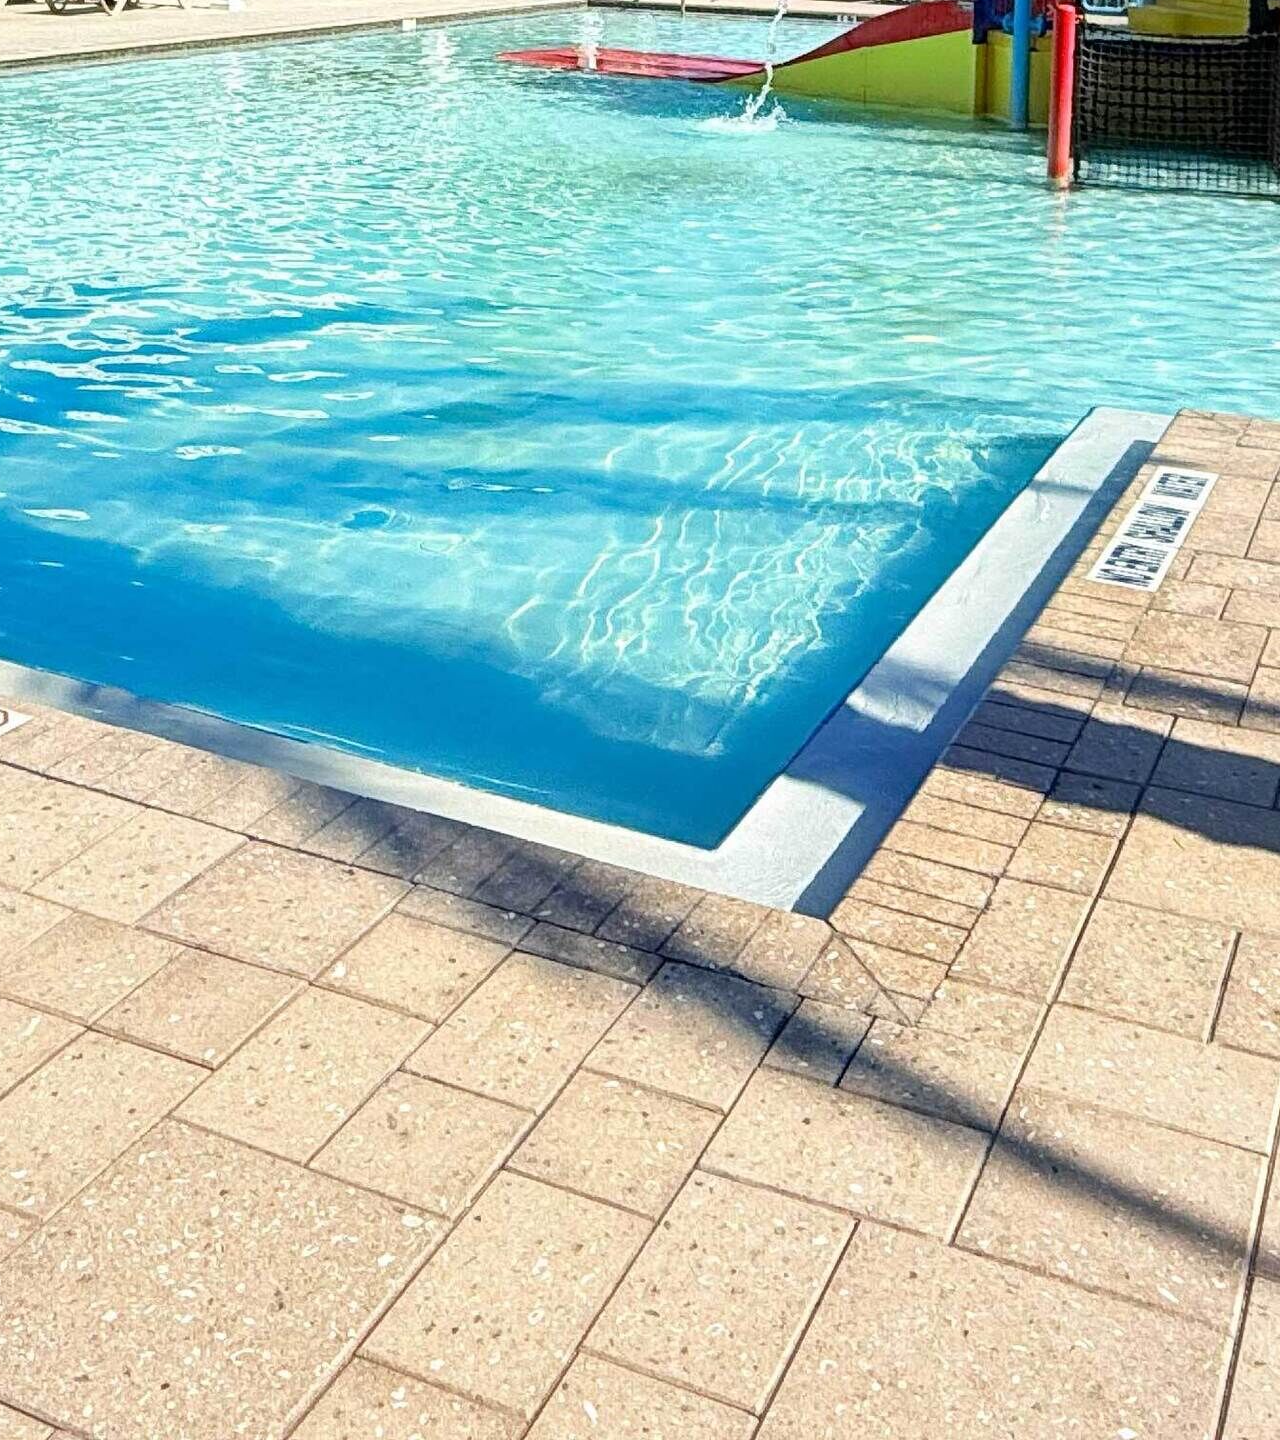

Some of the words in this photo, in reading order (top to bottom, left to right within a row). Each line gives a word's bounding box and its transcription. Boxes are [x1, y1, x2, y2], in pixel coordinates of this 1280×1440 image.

[1151, 472, 1209, 500] WATER
[1124, 503, 1190, 544] SHALLOW
[1105, 542, 1168, 573] ENTRY
[1095, 568, 1154, 588] NO
